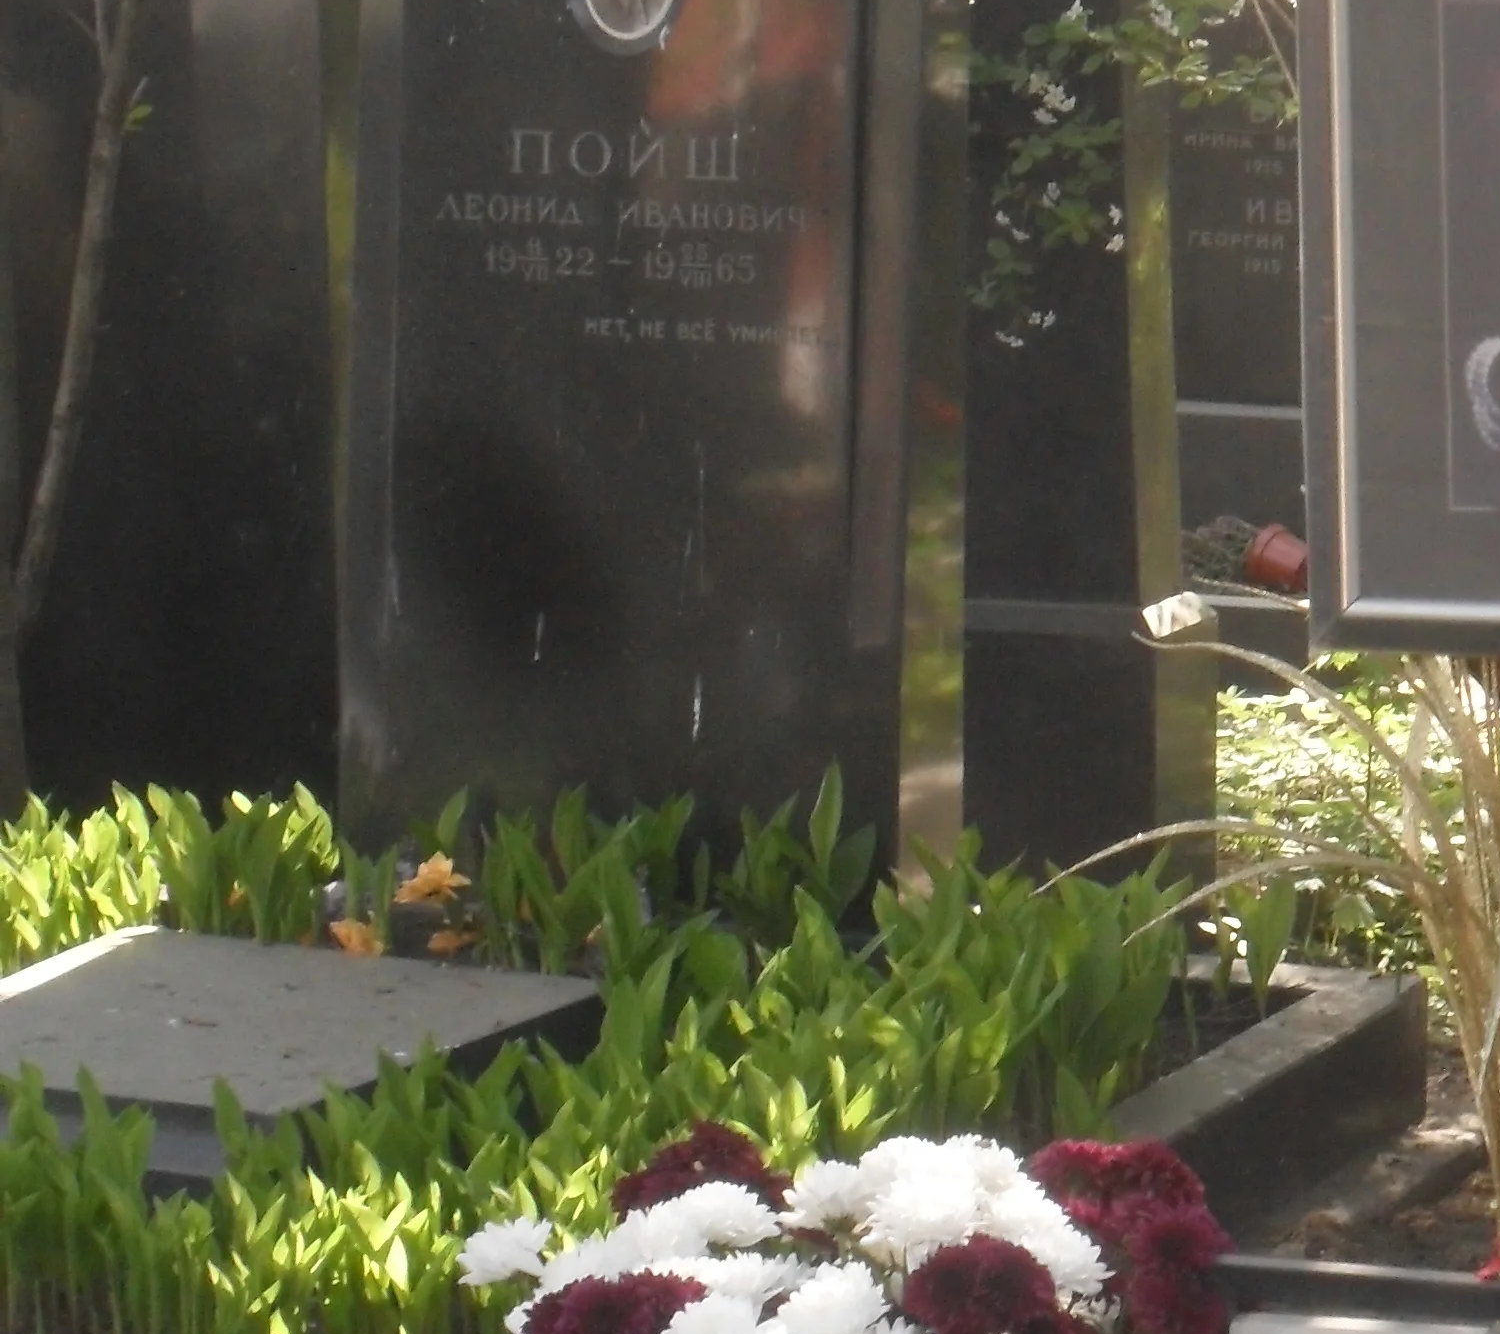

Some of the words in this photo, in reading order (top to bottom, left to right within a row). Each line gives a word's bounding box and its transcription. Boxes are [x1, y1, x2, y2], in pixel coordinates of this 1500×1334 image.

[511, 118, 739, 181] ПОЙШ
[437, 194, 582, 225] ЛЕОНИД
[618, 200, 805, 234] ИВАНОВИЧ
